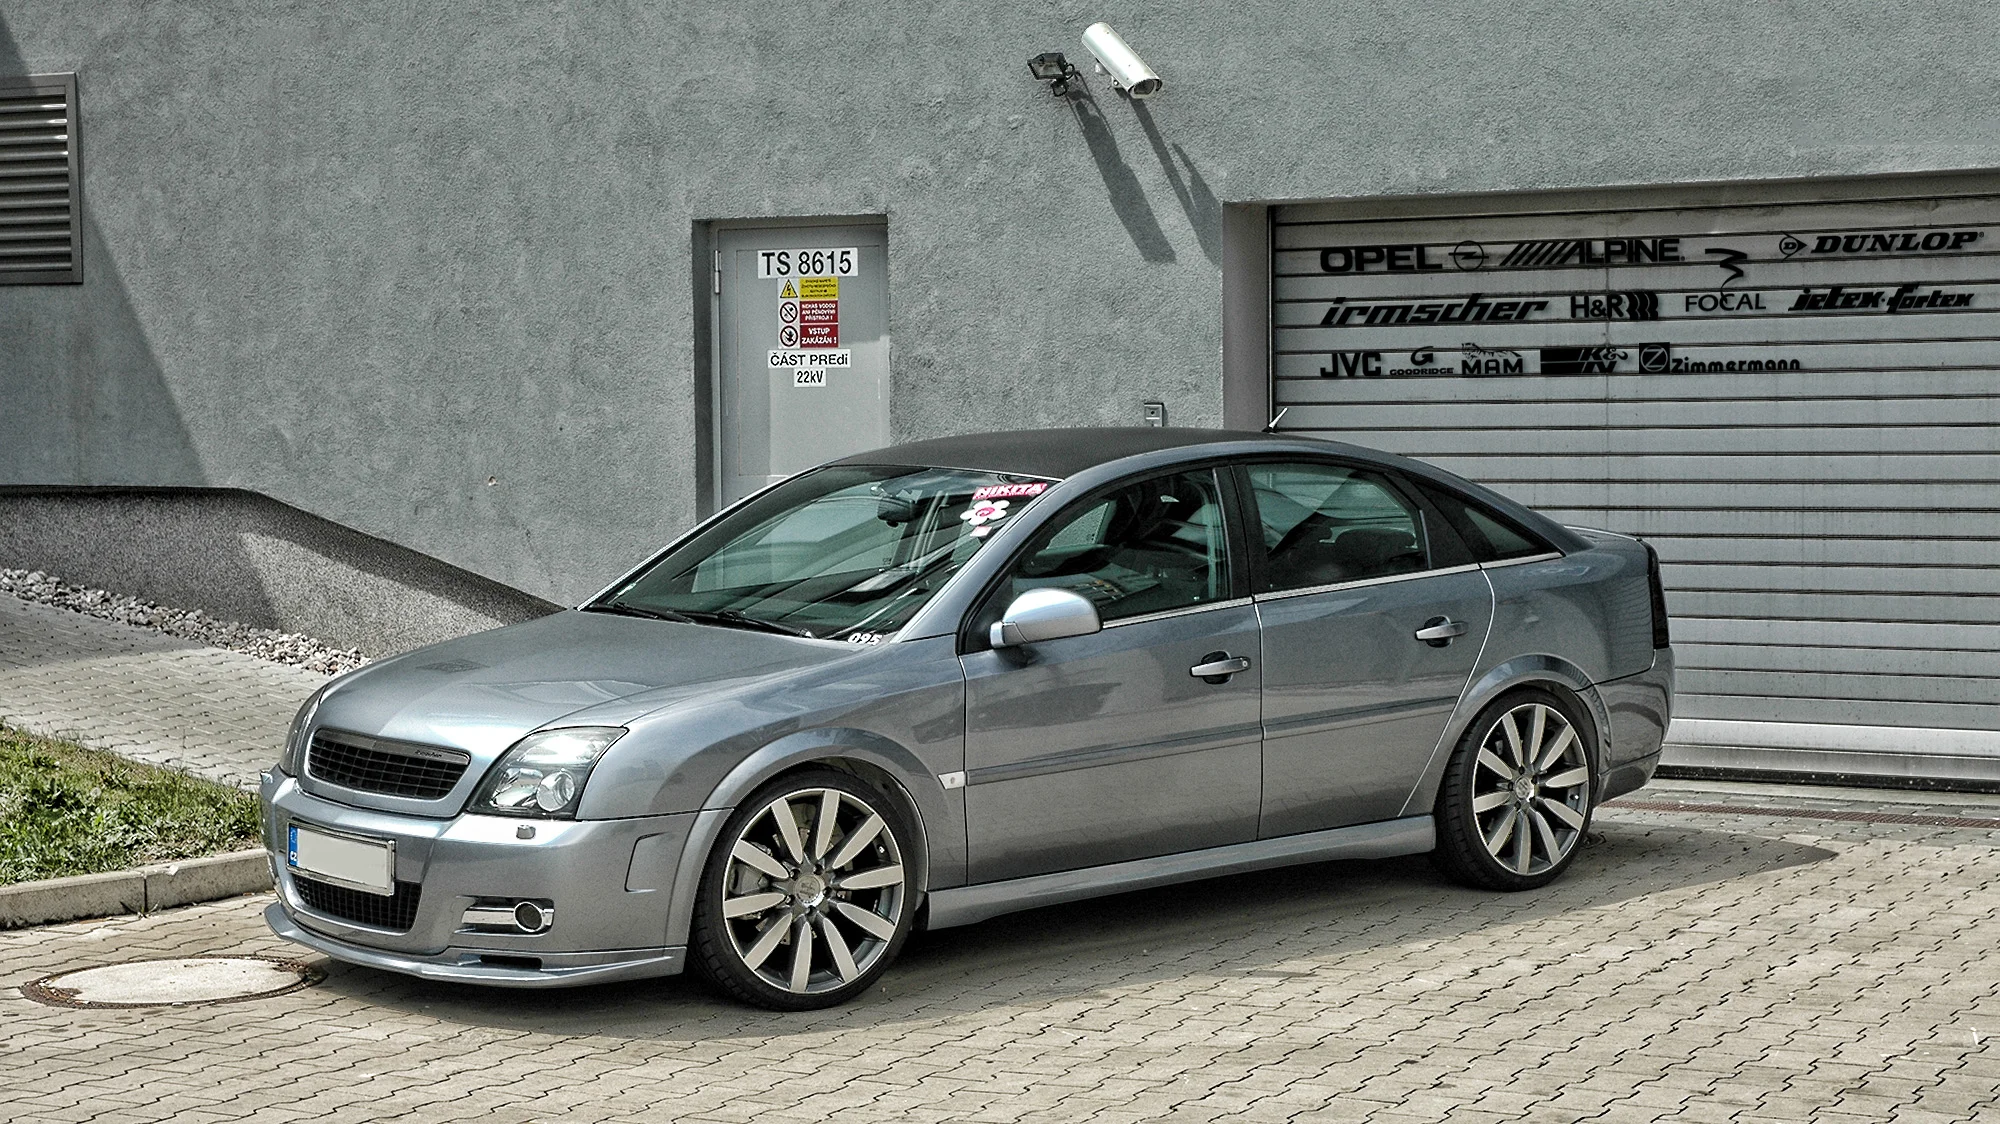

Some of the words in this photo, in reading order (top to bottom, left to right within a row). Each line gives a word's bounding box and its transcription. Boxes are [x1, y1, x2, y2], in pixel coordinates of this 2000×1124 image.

[1811, 231, 1979, 253] DUNLOP
[1320, 246, 1443, 272] OPEL
[1556, 239, 1680, 265] ALPINE
[762, 251, 791, 275] TS
[798, 250, 852, 274] 8615
[1320, 293, 1549, 325] irmscher
[1570, 294, 1624, 318] H&R
[1685, 293, 1766, 312] FOCAL
[801, 336, 832, 344] ZAKÁZÁN
[808, 327, 831, 335] VSTUP
[770, 351, 806, 366] ČÁST
[809, 353, 849, 366] PREdi
[1320, 352, 1382, 378] JVC
[1462, 358, 1524, 375] MAM
[1671, 356, 1800, 373] Zimmermann
[797, 370, 824, 384] 22kV
[1389, 367, 1454, 376] GOODRIDGE
[847, 632, 883, 646] 095
